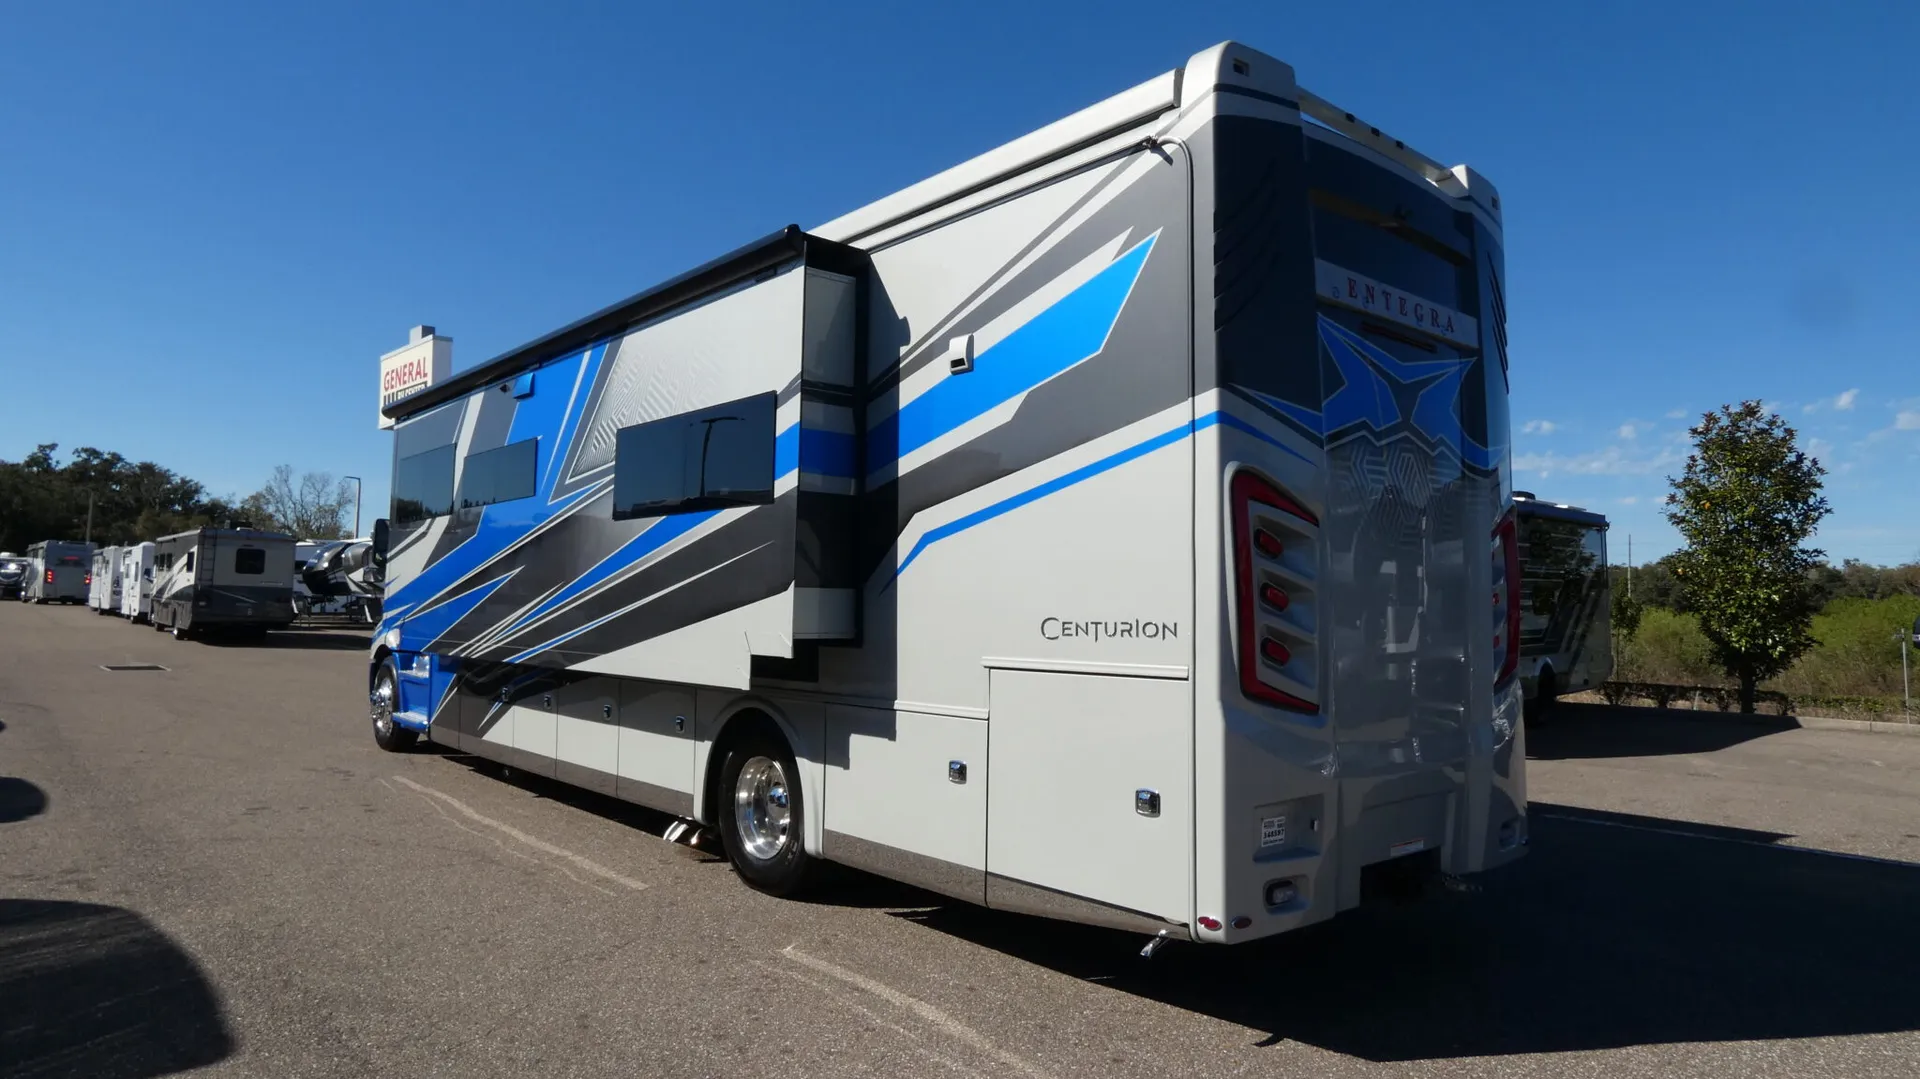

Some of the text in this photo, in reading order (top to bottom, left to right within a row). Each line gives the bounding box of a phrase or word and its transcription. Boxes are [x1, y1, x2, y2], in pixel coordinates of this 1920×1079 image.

[1347, 277, 1455, 333] ENTEGRA
[383, 356, 428, 392] GENERAL
[1040, 616, 1178, 643] CENTURION
